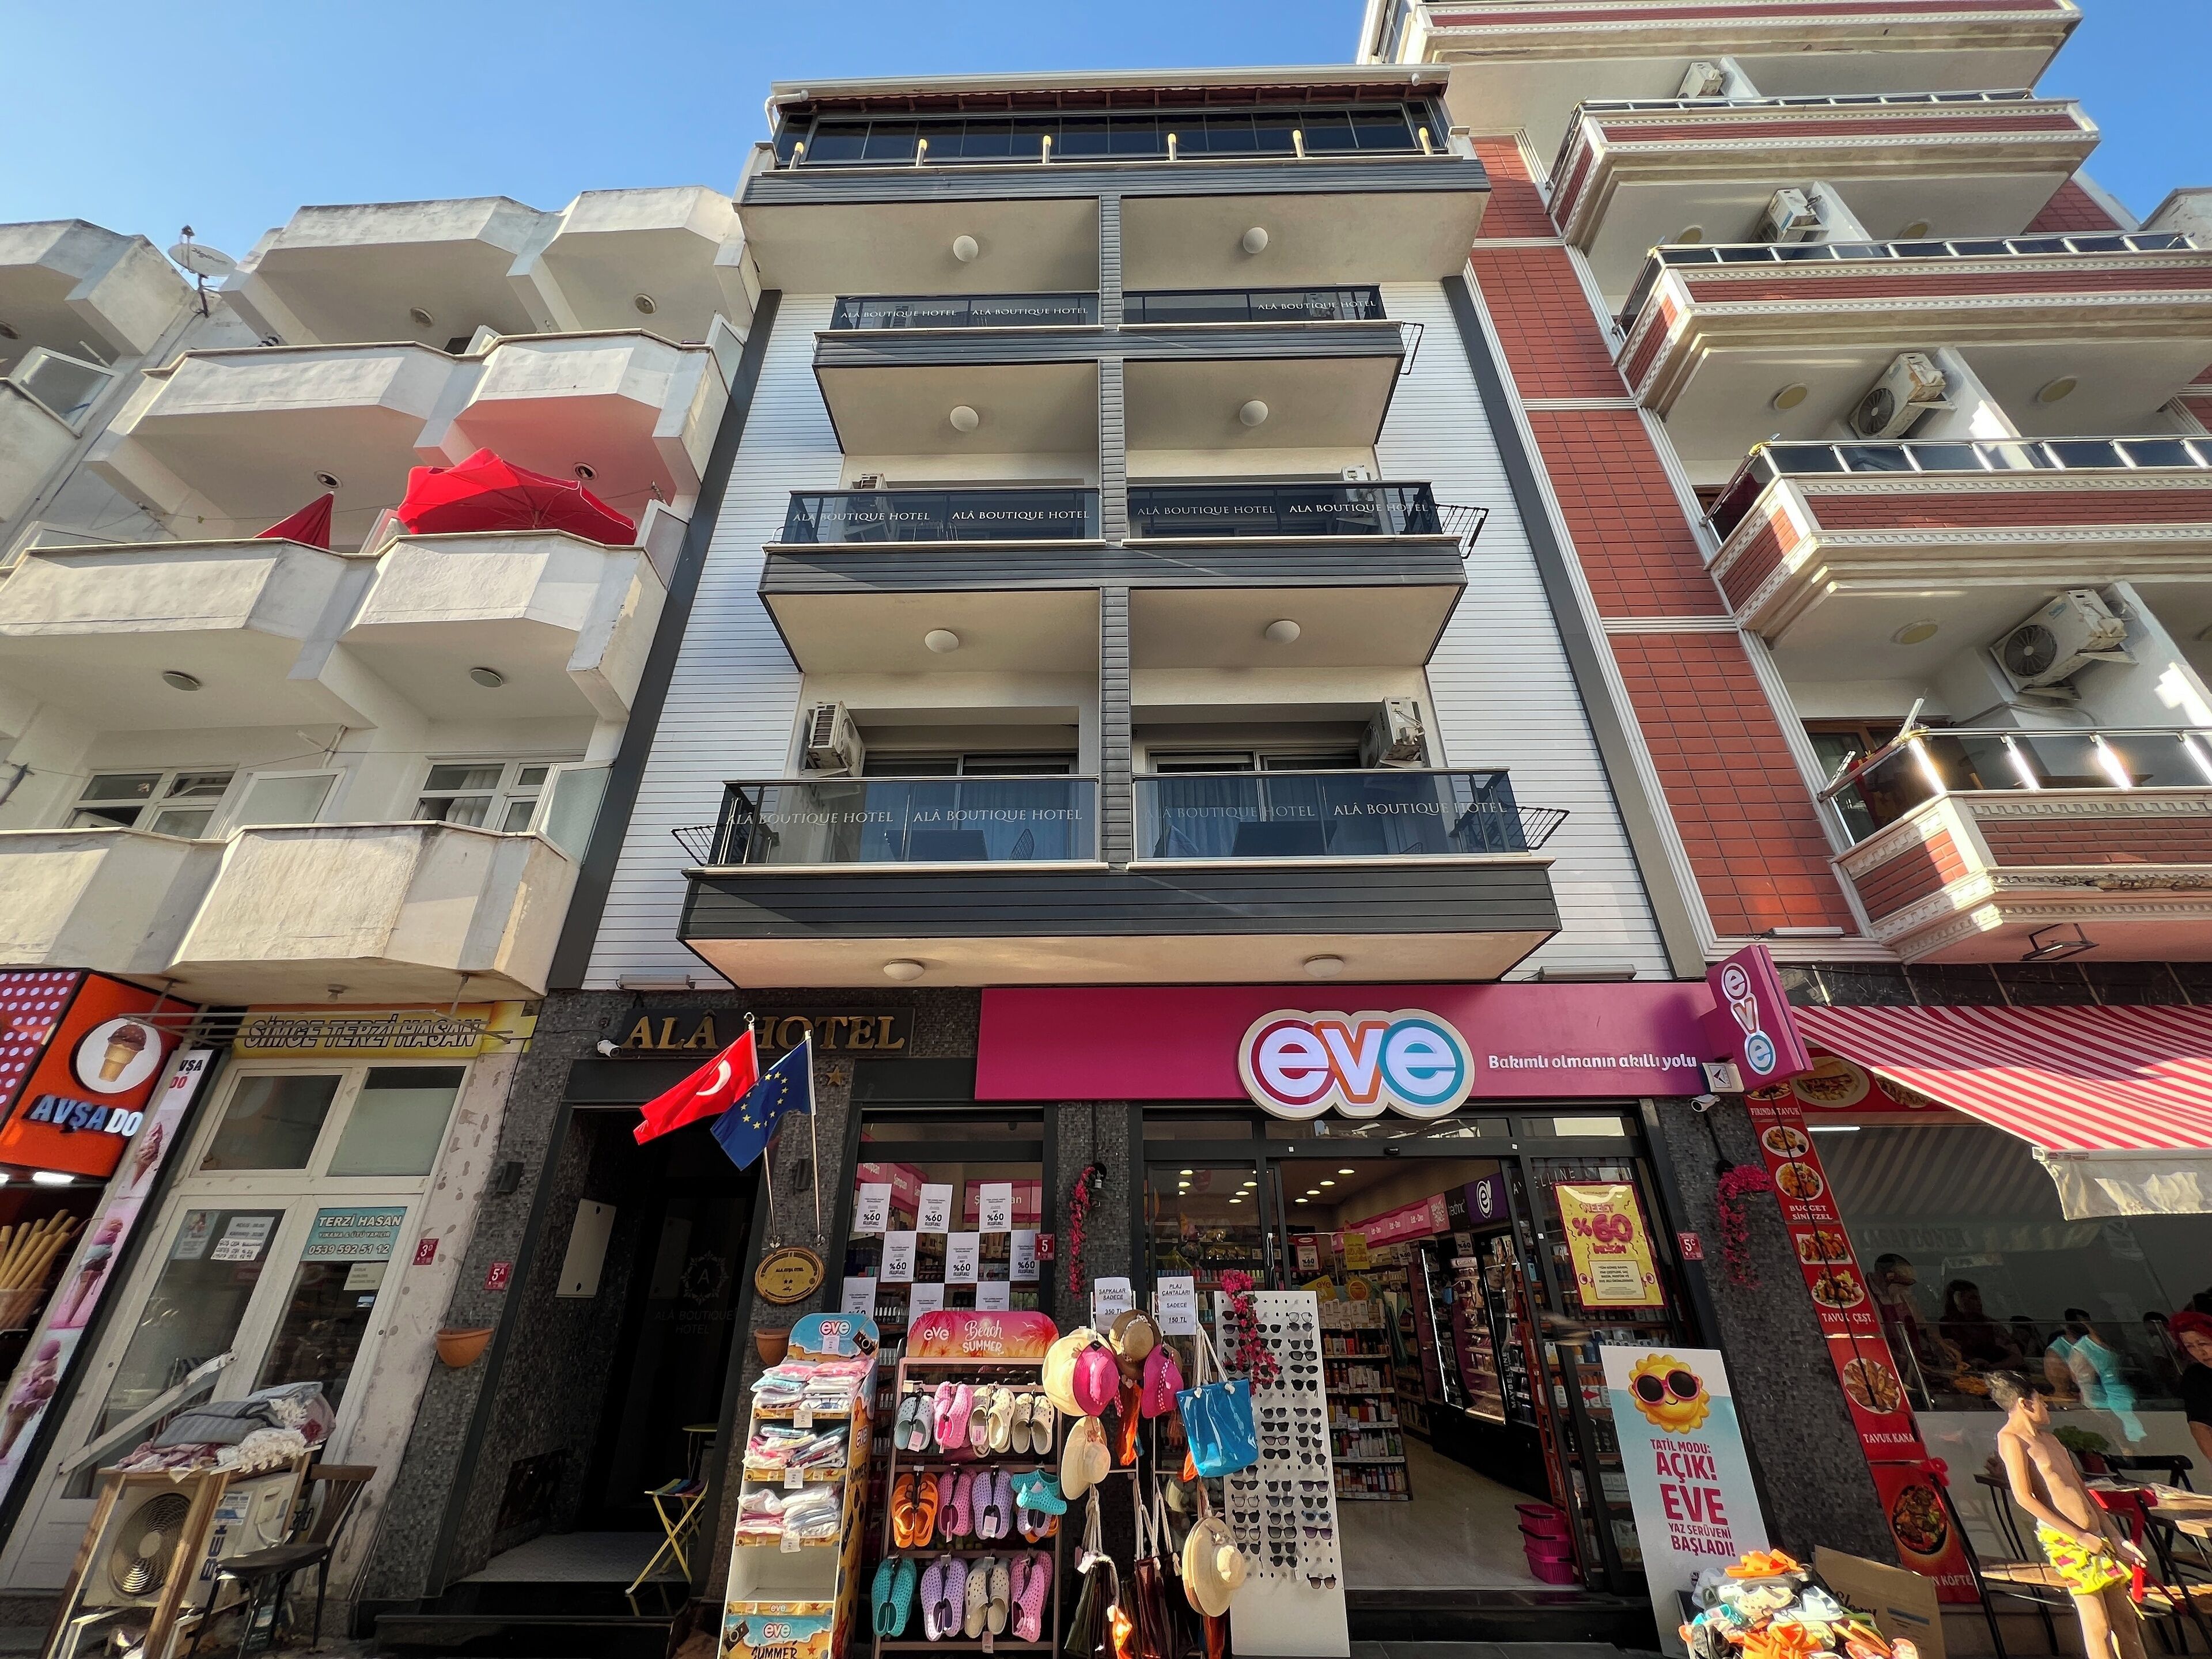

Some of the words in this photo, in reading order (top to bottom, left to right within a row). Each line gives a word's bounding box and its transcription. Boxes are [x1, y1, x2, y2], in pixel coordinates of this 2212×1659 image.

[1281, 302, 1337, 310] BOUTIQUE
[1164, 506, 1229, 516] BOUTIQUE
[1234, 506, 1275, 514] HOTEL
[1316, 503, 1382, 513] BOUTIQUE
[1386, 502, 1429, 512] HOTEL
[820, 512, 885, 522] BOUTIQUE
[889, 512, 930, 520] HOTEL
[979, 511, 1044, 521] BOUTIQUE
[1048, 510, 1090, 519] HOTEL
[1178, 806, 1257, 820] BOUTIQUE
[1263, 805, 1316, 817] HOTEL
[1334, 802, 1362, 816] ALÂ
[1367, 803, 1448, 816] BOUTIQUE
[1455, 801, 1508, 813] HOTEL
[759, 812, 839, 825] BOUTIQUE
[843, 811, 893, 823] HOTEL
[913, 809, 941, 822] ALÂ
[946, 810, 1027, 823] BOUTIQUE
[1032, 809, 1083, 820] HOTEL
[1724, 965, 1773, 1071] eve
[323, 1013, 399, 1048] TERZİ
[394, 1018, 483, 1048] HASAN
[622, 1009, 719, 1050] ALÂ
[750, 1015, 906, 1050] HOTEL
[178, 1059, 203, 1075] VŞA
[1250, 1018, 1465, 1107] eve
[1488, 1055, 1549, 1069] Bakımlı
[1552, 1054, 1616, 1069] olmanın
[1619, 1054, 1661, 1068] akıllı
[1661, 1054, 1698, 1071] yolu
[1750, 1108, 1775, 1116] FIRINDA
[1776, 1107, 1801, 1116] TAVUK
[318, 1213, 357, 1227] TERZİ
[357, 1215, 403, 1227] HASAN
[863, 1213, 881, 1221] %60
[987, 1213, 1004, 1221] %60
[1571, 1214, 1633, 1242] %60
[308, 1244, 336, 1255] 0539
[336, 1244, 358, 1255] 592
[359, 1244, 374, 1255] 51
[376, 1243, 391, 1254] 12
[1041, 1239, 1048, 1252] 5
[889, 1262, 907, 1270] %60
[953, 1263, 971, 1271] %60
[1018, 1260, 1035, 1269] %60
[1316, 1281, 1332, 1289] eve
[679, 1310, 733, 1322] BOUTIQUE
[1821, 1313, 1850, 1323] TAVUK
[675, 1325, 710, 1334] HOTEL
[820, 1320, 851, 1336] eve
[923, 1326, 950, 1341] eve
[965, 1320, 1005, 1341] Beach
[963, 1339, 1003, 1354] SUMMER
[1502, 1352, 1516, 1408] MAYBELLINE
[1862, 1433, 1892, 1444] TAVUK
[1892, 1433, 1916, 1444] KANA
[1650, 1438, 1677, 1452] TATİL
[1677, 1441, 1711, 1454] MODU:
[1656, 1452, 1717, 1483] AÇIK!
[1660, 1483, 1729, 1526] EVE
[1668, 1522, 1686, 1534] YAZ
[1688, 1523, 1732, 1539] SERÜVENİ
[1671, 1535, 1736, 1556] BAŞLADI!
[1940, 1572, 1974, 1586] KÖFTE
[770, 1603, 787, 1612] eve
[763, 1623, 791, 1638] eve
